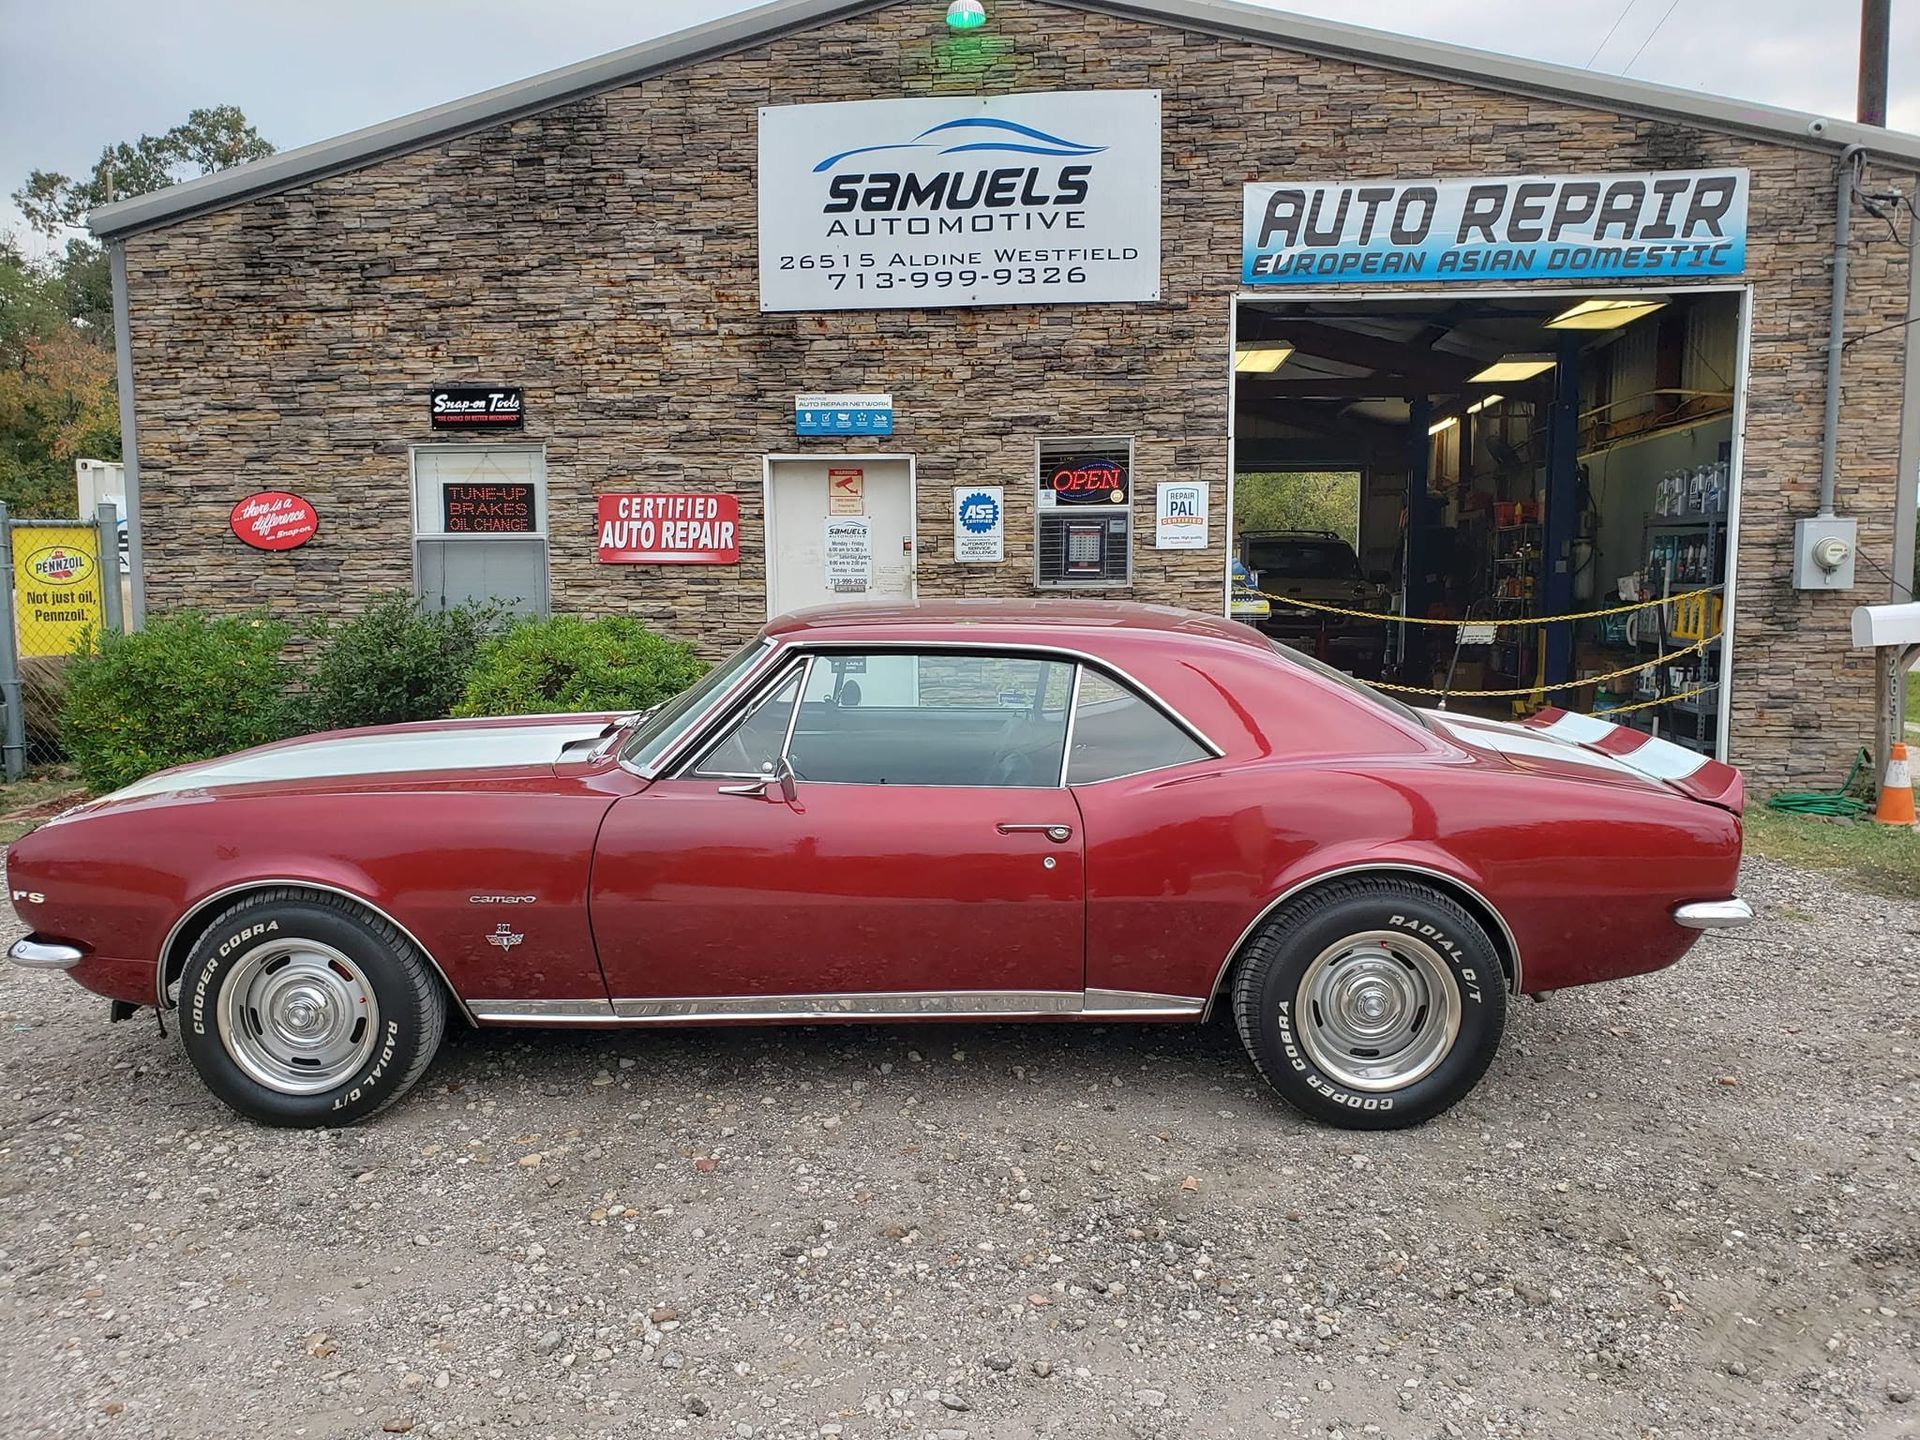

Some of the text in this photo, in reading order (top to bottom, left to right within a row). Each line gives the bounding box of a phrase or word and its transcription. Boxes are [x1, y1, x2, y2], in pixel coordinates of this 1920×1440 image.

[1258, 176, 1737, 248] AUTO REPAIR
[826, 210, 1086, 237] AUTOMOTIVE
[779, 253, 875, 270] 26515
[1252, 244, 1733, 277] EUROPEAN ASIAN DOMESTIC
[828, 267, 1087, 290] 713-999-9326
[433, 393, 520, 413] Snap-on Tools
[1054, 469, 1120, 491] OPEN
[448, 487, 527, 500] TUNE-UP
[1170, 492, 1195, 500] REPAIR
[449, 502, 528, 515] BRAKES
[618, 497, 718, 519] CERTIFIED
[964, 505, 993, 519] ASE
[1170, 501, 1194, 516] PAL
[450, 517, 528, 531] OIL CHANGE
[600, 521, 734, 549] AUTO REPAIR
[35, 556, 85, 574] PENNZOIL
[27, 591, 96, 606] Not just oil,
[469, 895, 537, 903] camaro
[1389, 915, 1463, 964] RADIAL
[193, 920, 280, 1035] COOPER COBRA
[363, 1020, 398, 1086] RADIAL
[1278, 1000, 1394, 1111] COOPER COBRA
